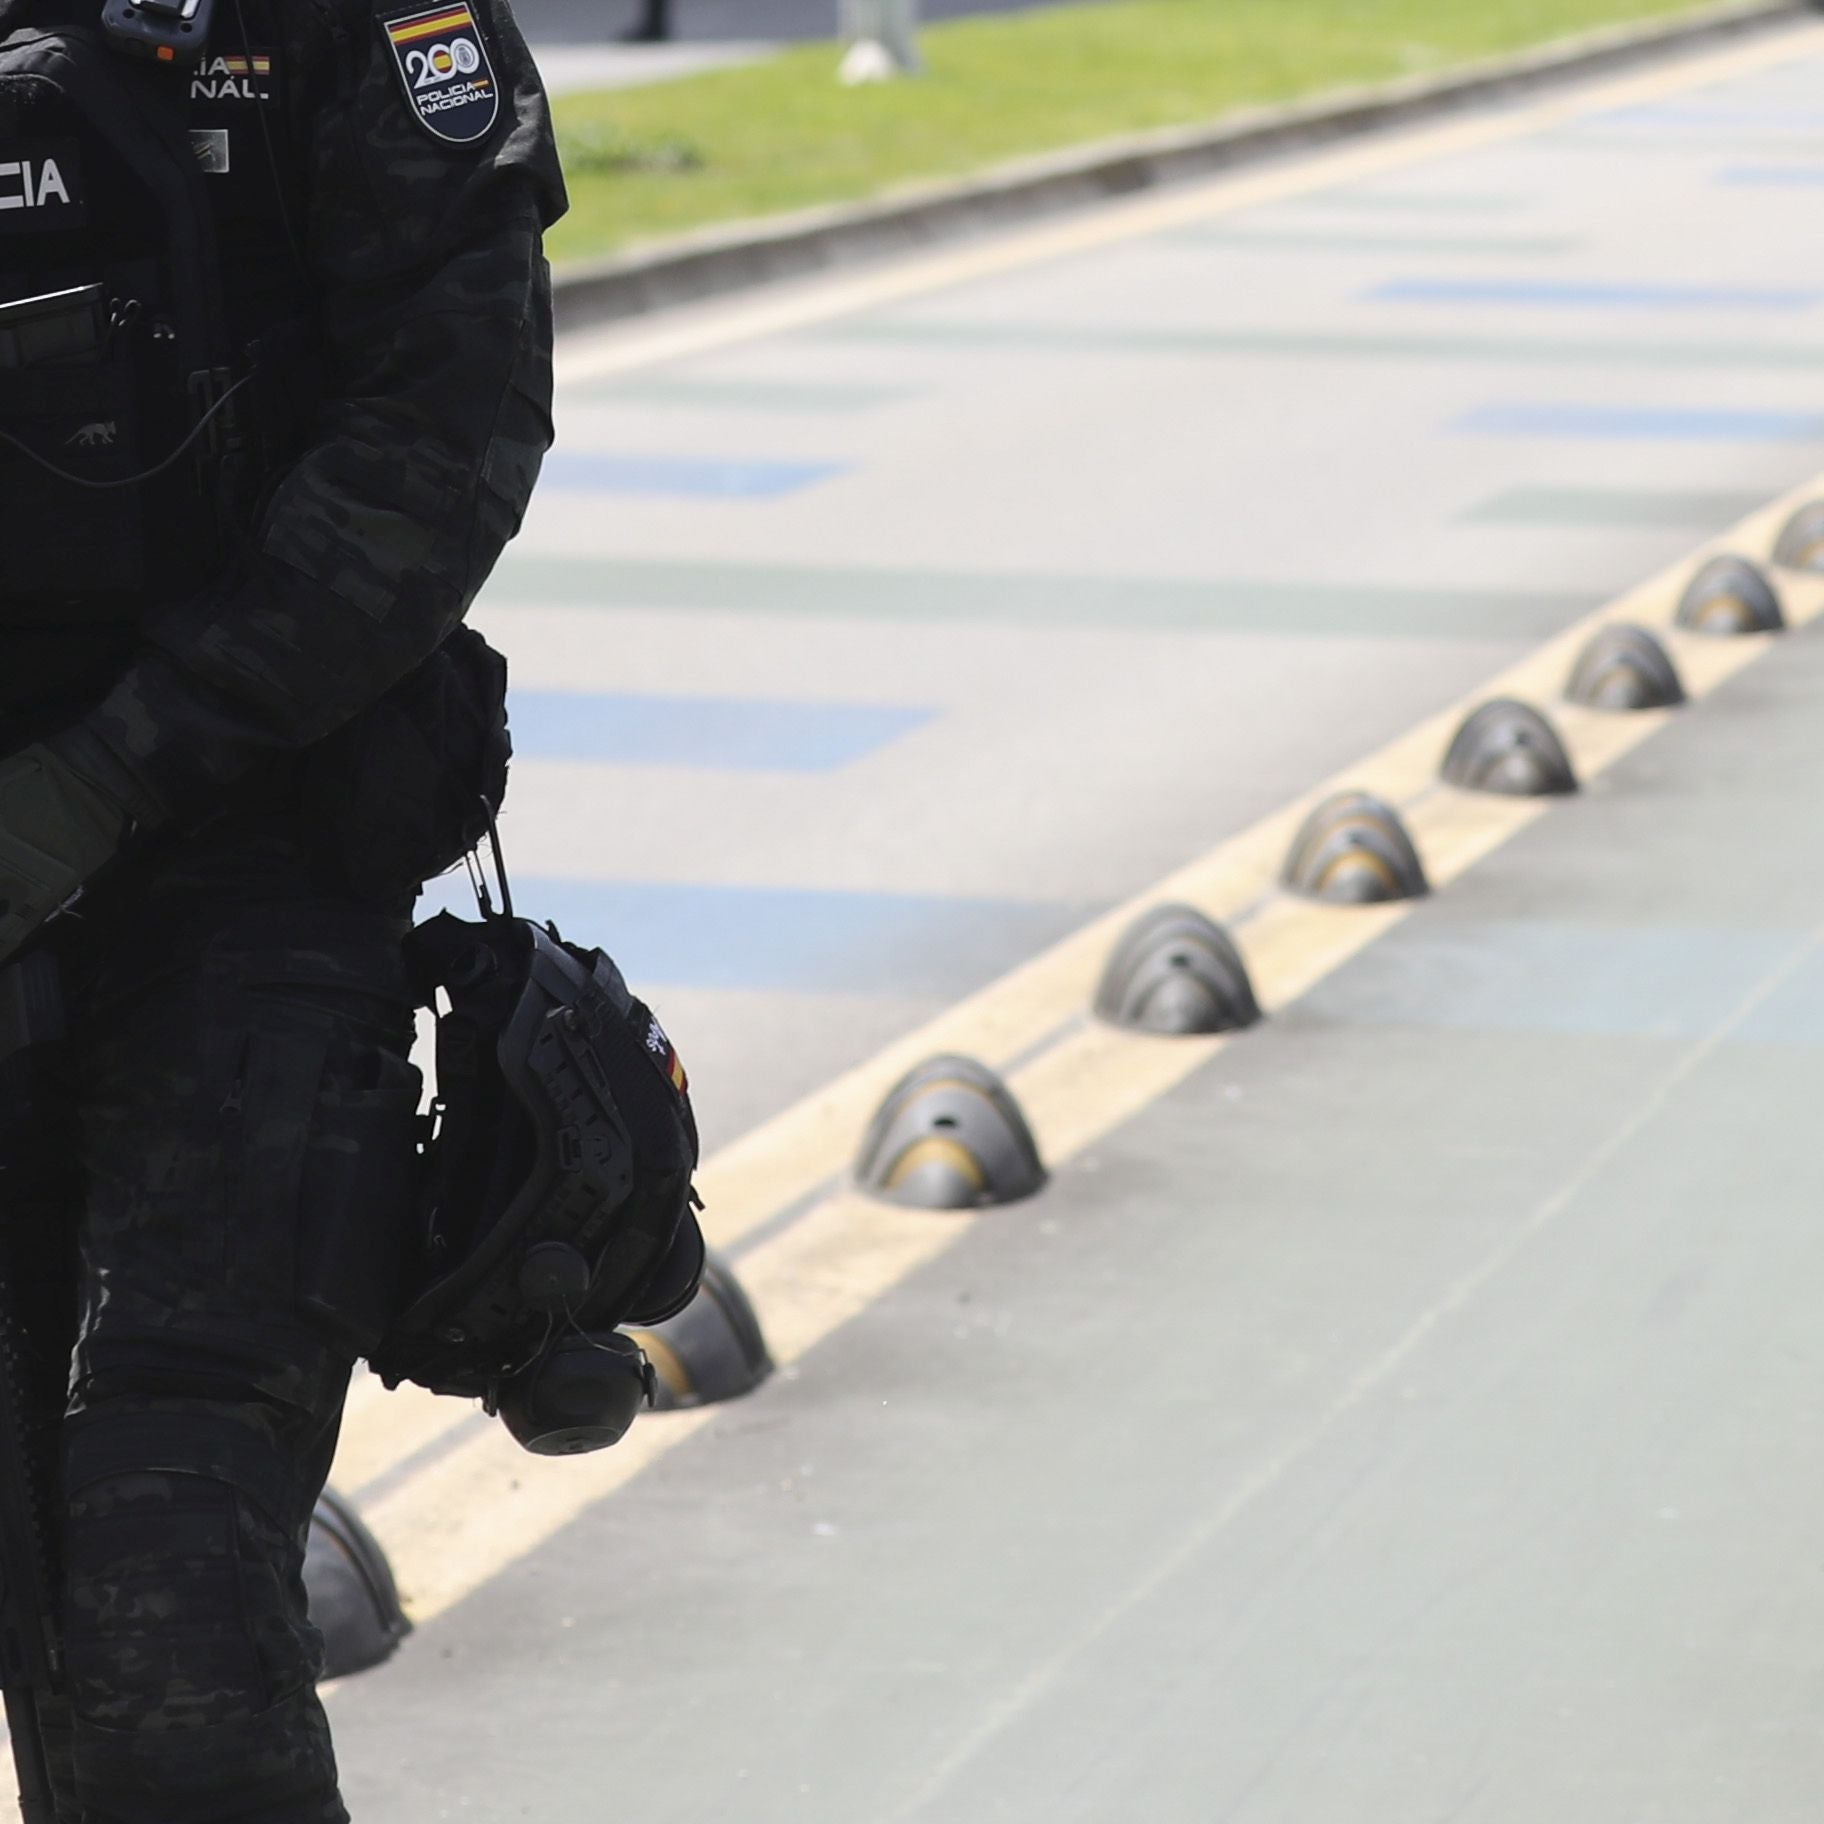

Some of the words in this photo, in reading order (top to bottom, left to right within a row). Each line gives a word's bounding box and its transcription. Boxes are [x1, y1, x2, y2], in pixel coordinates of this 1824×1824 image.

[405, 37, 480, 89] 200
[190, 79, 270, 99] NAL
[416, 81, 476, 106] POLICIA
[419, 88, 494, 116] NACIONAL
